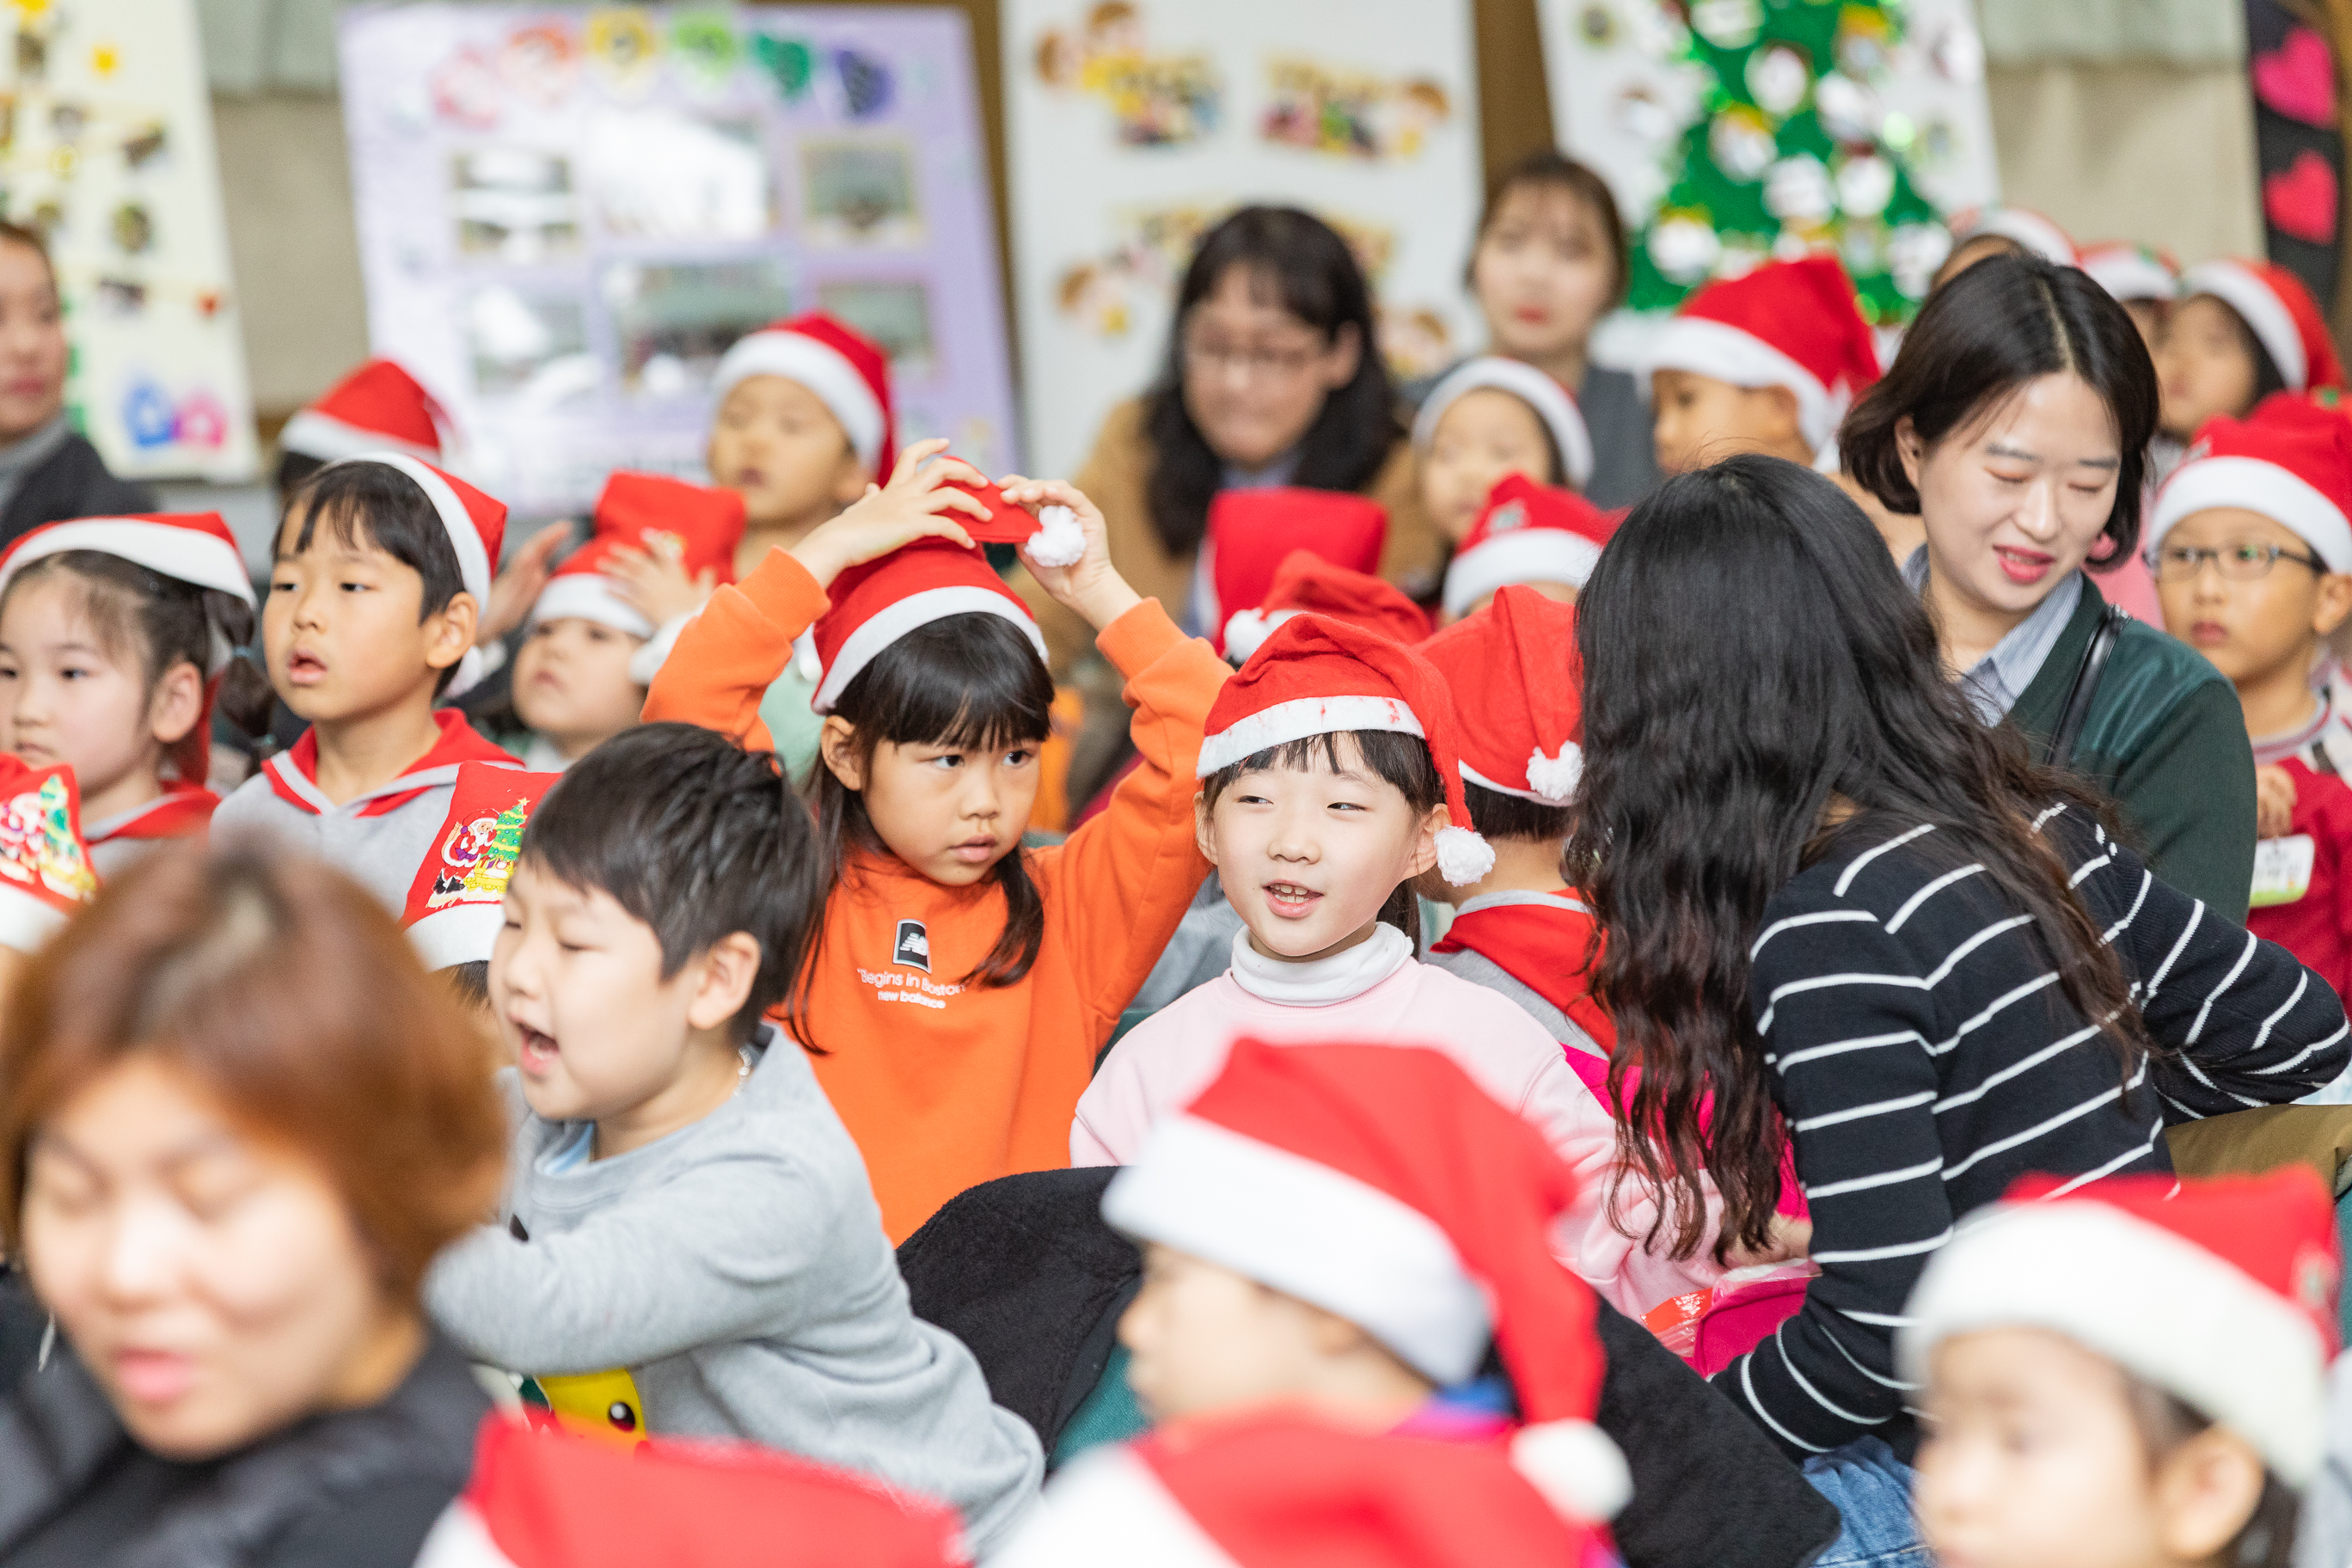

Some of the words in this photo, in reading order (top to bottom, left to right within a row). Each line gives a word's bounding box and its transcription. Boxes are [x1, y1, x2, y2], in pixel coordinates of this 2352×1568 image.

[906, 972, 921, 989] in
[877, 991, 899, 1001] new
[899, 989, 946, 1009] balance
